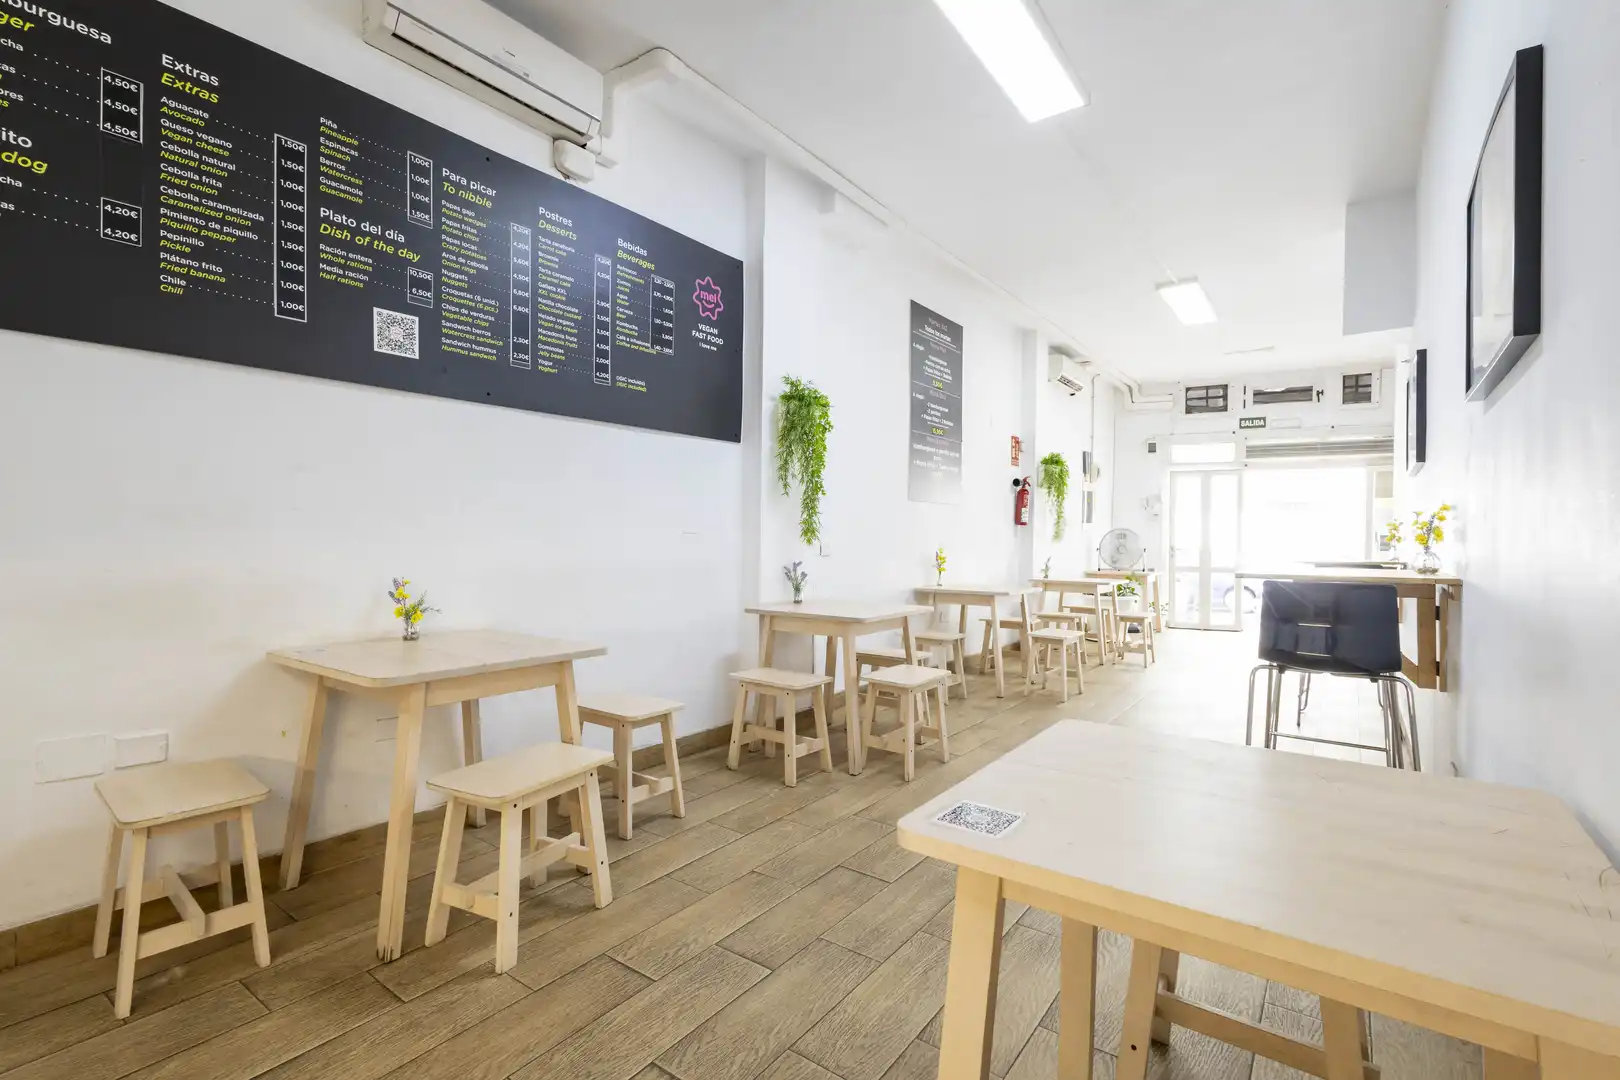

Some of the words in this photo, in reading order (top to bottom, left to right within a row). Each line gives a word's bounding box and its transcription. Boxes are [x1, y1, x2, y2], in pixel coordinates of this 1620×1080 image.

[0, 0, 112, 44] burguesa
[162, 54, 219, 86] Extras
[104, 75, 138, 92] 4,50€
[161, 72, 220, 103] Extras
[104, 98, 138, 116] 4,50€
[160, 96, 210, 119] Aguacate
[160, 106, 206, 127] Avocado
[320, 116, 338, 129] Piña
[104, 122, 138, 139] 4,50€
[160, 118, 194, 136] Queso
[196, 131, 232, 148] vegano
[320, 126, 359, 146] Pineapple
[160, 128, 193, 144] Vegan
[196, 141, 230, 157] cheese
[281, 138, 304, 152] 1,50€
[320, 136, 359, 157] Espinacas
[1, 151, 48, 174] dog
[160, 140, 200, 159] Cebolla
[202, 154, 236, 171] natural
[320, 146, 350, 162] Spinach
[411, 155, 430, 168] 1,00€
[160, 150, 198, 168] Natural
[200, 163, 228, 178] onion
[280, 158, 304, 172] 1,50€
[320, 156, 346, 171] Berros
[160, 163, 200, 180] Cebolla
[202, 176, 222, 188] frita
[160, 172, 188, 187] Fried
[190, 183, 218, 196] onion
[320, 165, 364, 186] Watercress
[411, 173, 430, 186] 1,00€
[442, 167, 467, 186] Para
[470, 180, 496, 197] picar
[280, 178, 304, 192] 1,00€
[320, 176, 364, 196] Guacamole
[320, 185, 364, 204] Guacamole
[411, 192, 430, 204] 1,00€
[442, 181, 456, 194] To
[458, 189, 492, 209] nibble
[104, 204, 138, 219] 4,20€
[160, 186, 200, 203] Cebolla
[202, 198, 264, 222] caramelizada
[160, 196, 223, 218] Caramelized
[225, 214, 252, 226] onion
[280, 200, 304, 212] 1,00€
[442, 200, 460, 212] Papas
[442, 207, 462, 220] Potato
[442, 216, 460, 228] Papas
[539, 206, 572, 227] Postres
[160, 208, 206, 226] Pimiento
[208, 220, 221, 230] de
[223, 226, 258, 240] piquillo
[160, 218, 198, 234] Piquillo
[200, 230, 236, 244] pepper
[280, 220, 304, 232] 1,50€
[320, 206, 356, 228] Plato
[360, 221, 382, 236] del
[385, 228, 405, 243] día
[442, 224, 462, 237] Potato
[463, 231, 480, 242] chips
[538, 220, 577, 240] Desserts
[104, 228, 138, 242] 4,20€
[160, 230, 204, 247] Pepinillo
[320, 223, 351, 241] Dish
[355, 234, 372, 246] of
[373, 239, 394, 254] the
[398, 244, 421, 264] day
[442, 234, 460, 246] Papas
[160, 240, 192, 253] Pickle
[280, 240, 304, 252] 1,50€
[320, 243, 347, 258] Ración
[348, 252, 373, 264] entera
[442, 241, 460, 253] Crazy
[460, 248, 488, 261] potatoes
[618, 238, 648, 256] Bebidas
[160, 252, 200, 268] Plátano
[202, 261, 222, 273] frito
[320, 252, 346, 264] Whole
[347, 260, 373, 272] rations
[442, 251, 456, 261] Aros
[617, 250, 655, 270] Beverages
[160, 262, 188, 274] Fried
[190, 268, 226, 283] banana
[280, 260, 304, 272] 1,00€
[320, 262, 344, 276] Media
[345, 270, 369, 282] ración
[442, 268, 468, 281] Nuggets
[160, 274, 187, 286] Chile
[280, 280, 304, 292] 1,00€
[319, 272, 336, 281] Half
[337, 276, 364, 288] rations
[442, 276, 468, 289] Nuggets
[160, 284, 184, 295] Chili
[442, 285, 473, 300] Croquetas
[280, 300, 304, 312] 1,00€
[442, 294, 475, 307] Croquettes
[442, 302, 460, 313] Chips
[470, 310, 494, 322] verduras
[442, 310, 472, 323] Vegetable
[474, 318, 489, 328] chips
[442, 320, 472, 332] Sandwich
[472, 328, 492, 337] berros
[442, 328, 476, 340] Watercress
[476, 336, 504, 346] sandwich
[692, 330, 706, 340] FAST
[708, 334, 724, 345] FOOD
[698, 323, 718, 335] VEGAN
[442, 337, 472, 348] Sandwich
[472, 344, 496, 354] hummus
[442, 344, 468, 356] Hummus
[470, 350, 496, 361] sandwich
